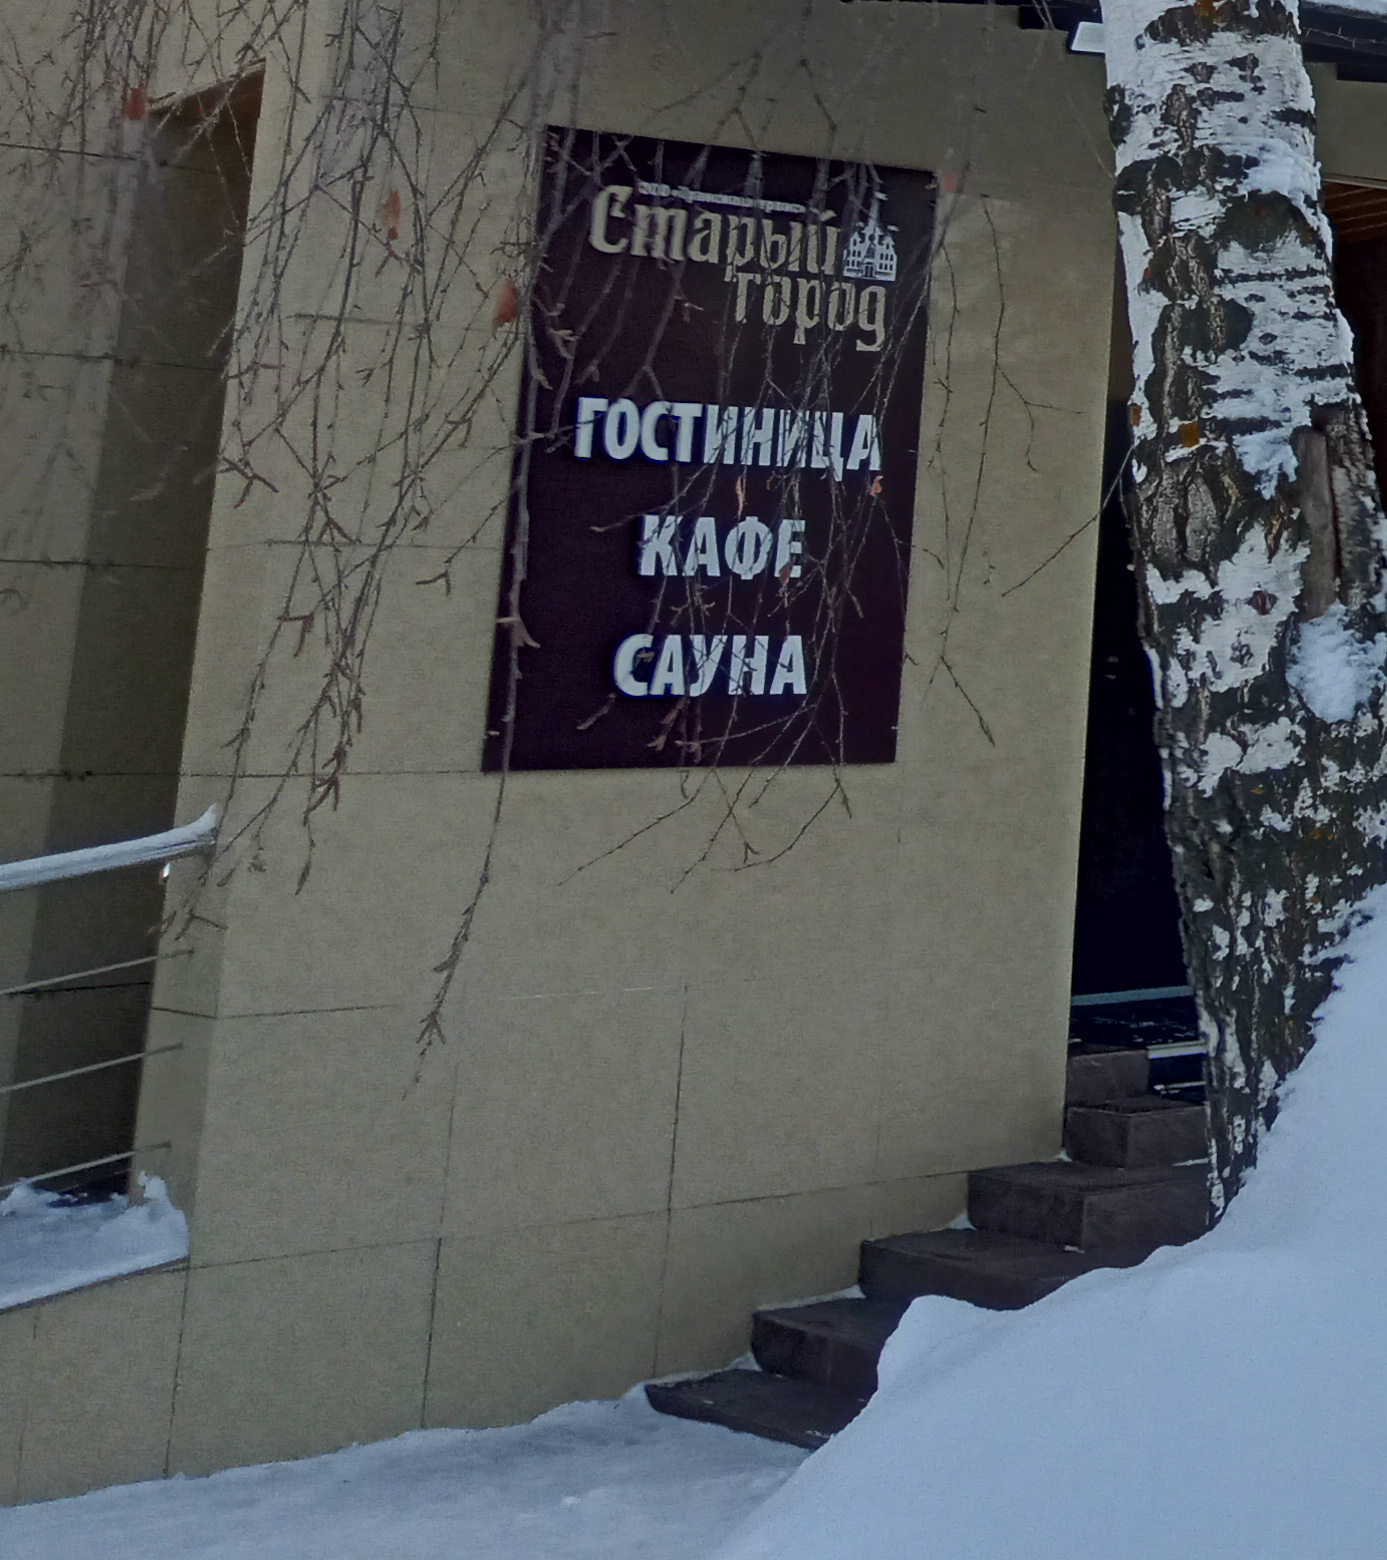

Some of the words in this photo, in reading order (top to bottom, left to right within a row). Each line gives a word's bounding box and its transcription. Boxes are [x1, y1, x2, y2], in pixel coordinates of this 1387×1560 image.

[590, 184, 839, 282] Старый
[574, 396, 882, 482] ГОСТИНИЦА
[638, 514, 806, 580] КАФЕ
[613, 633, 808, 698] САУНА
